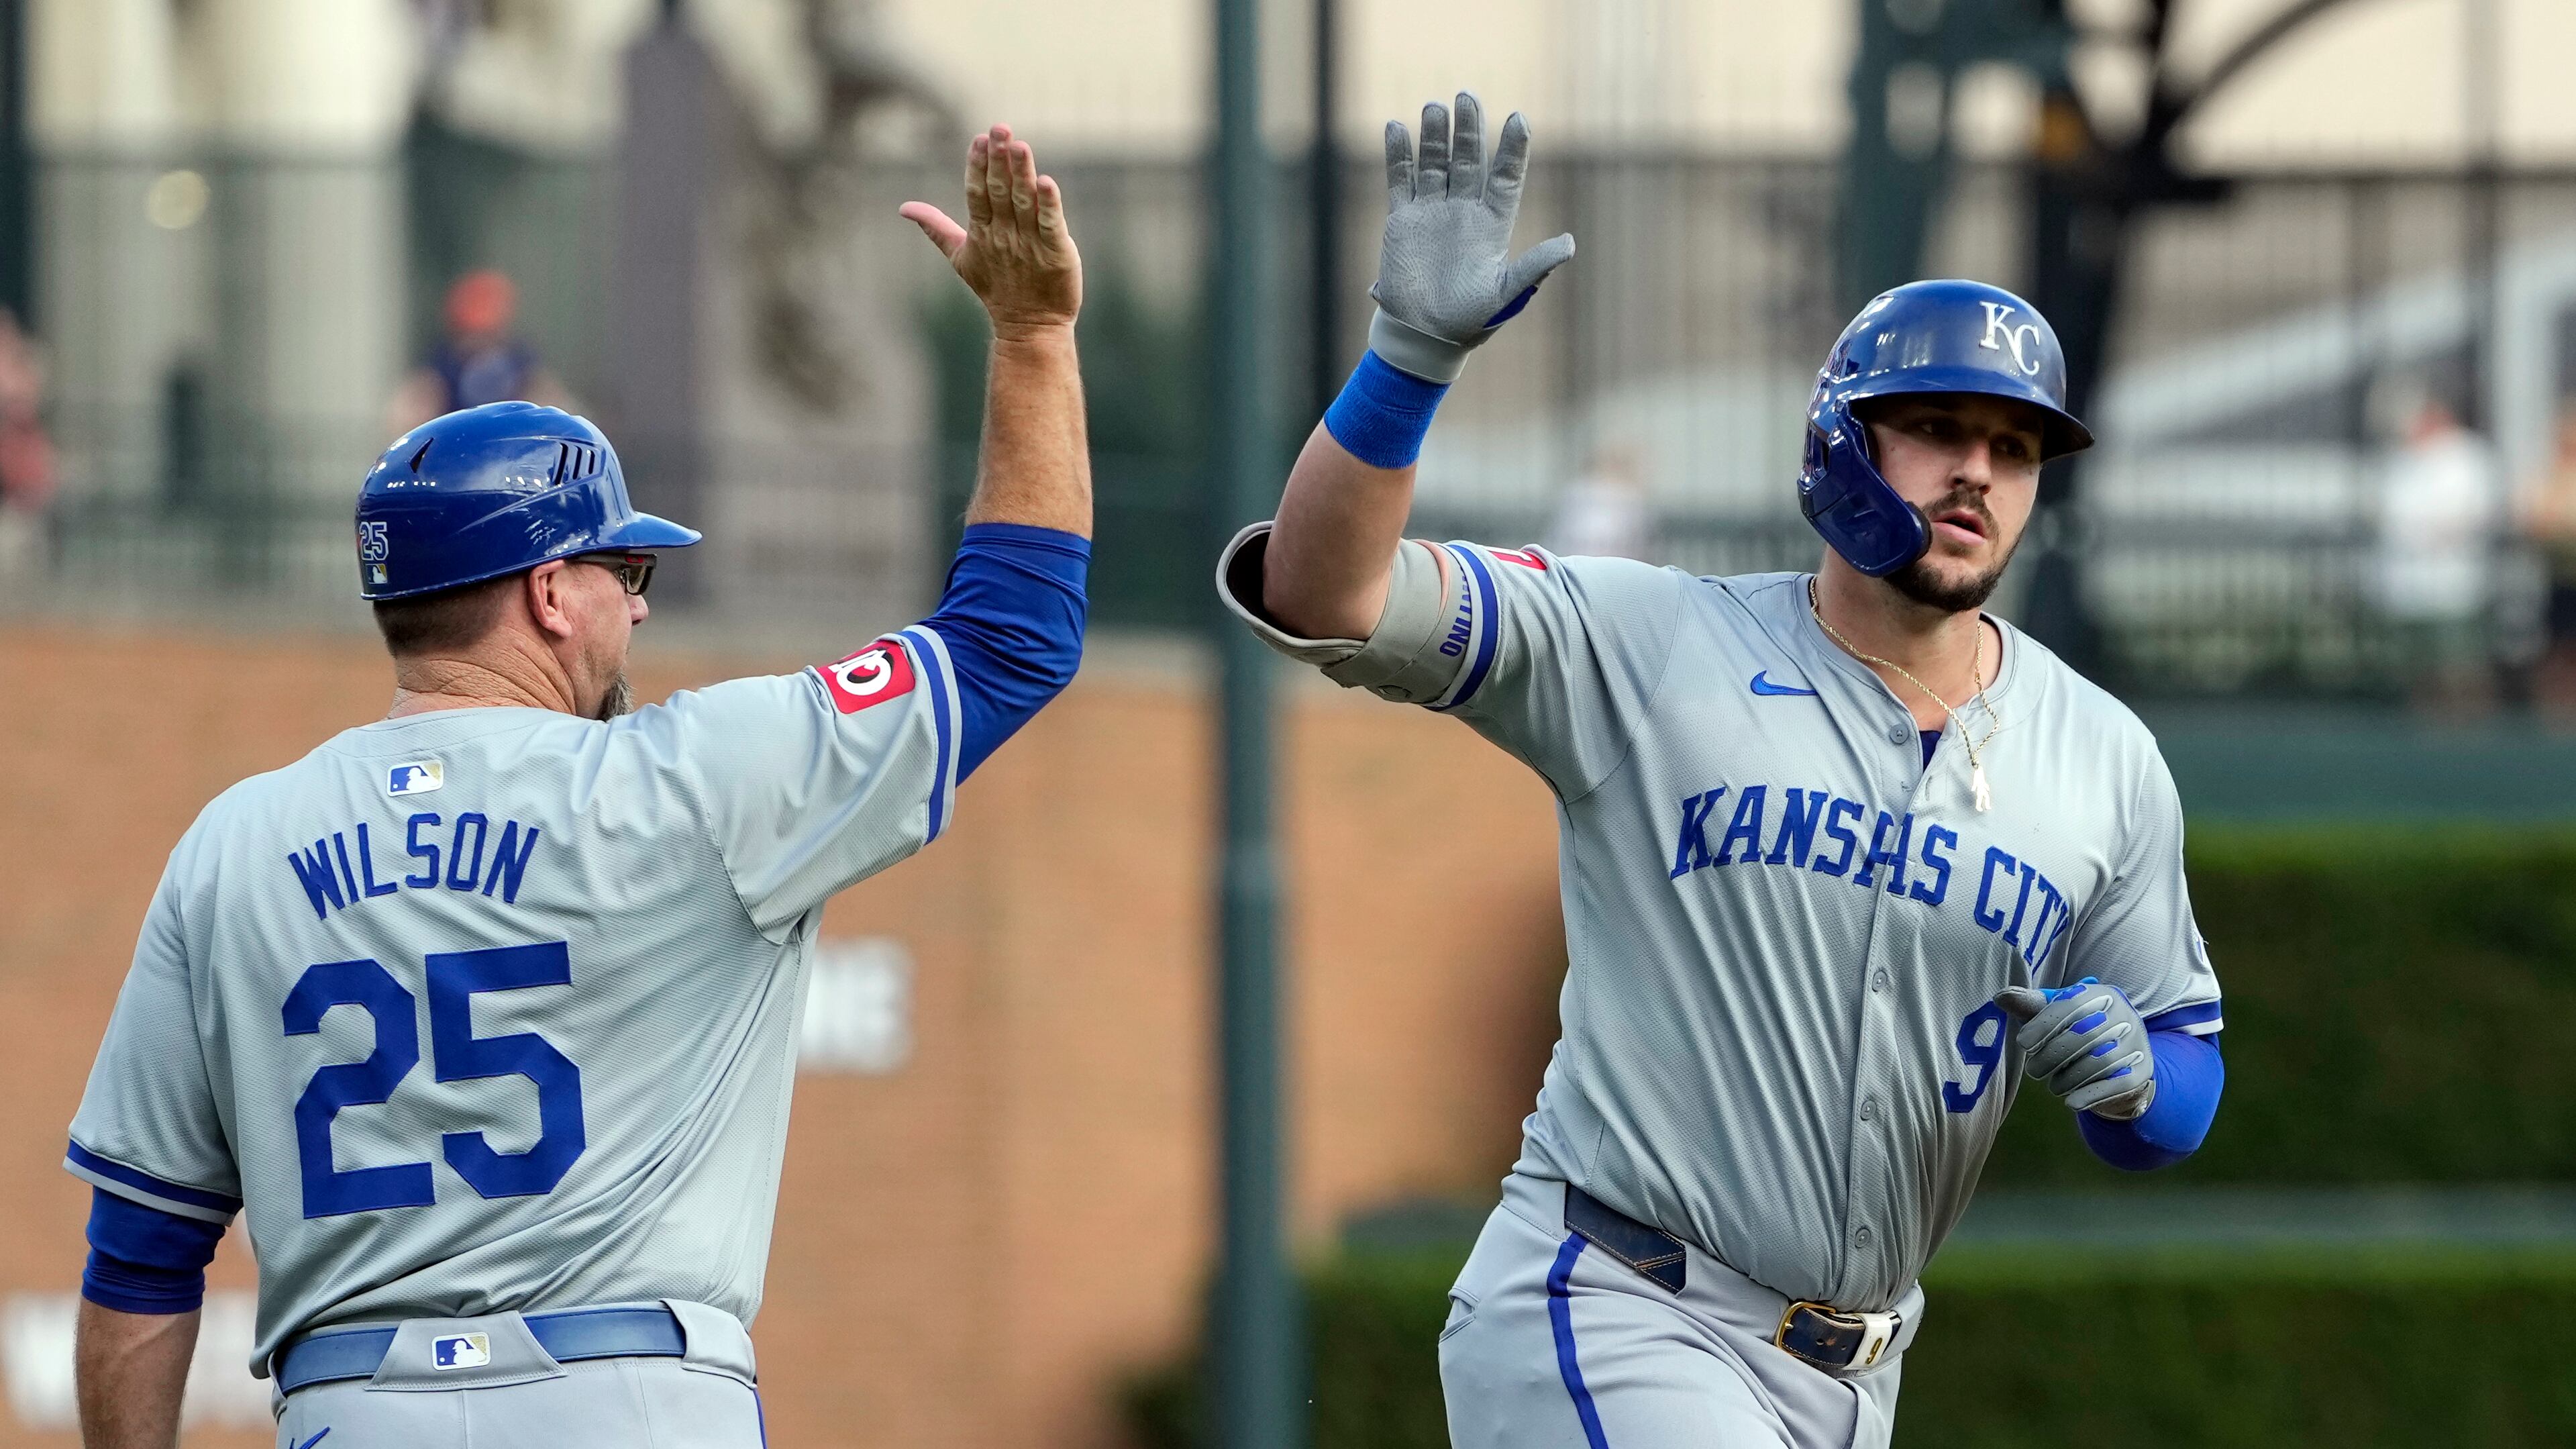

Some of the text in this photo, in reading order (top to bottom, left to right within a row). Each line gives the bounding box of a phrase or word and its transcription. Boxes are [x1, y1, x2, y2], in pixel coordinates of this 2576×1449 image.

[1979, 301, 2040, 377] KC
[359, 521, 389, 561] 25
[288, 812, 539, 921] WILSON
[1669, 784, 2069, 979] KANSAS CITY
[282, 941, 586, 1219] 25
[1943, 1000, 2008, 1113] 9
[1865, 1337, 1883, 1364] 9
